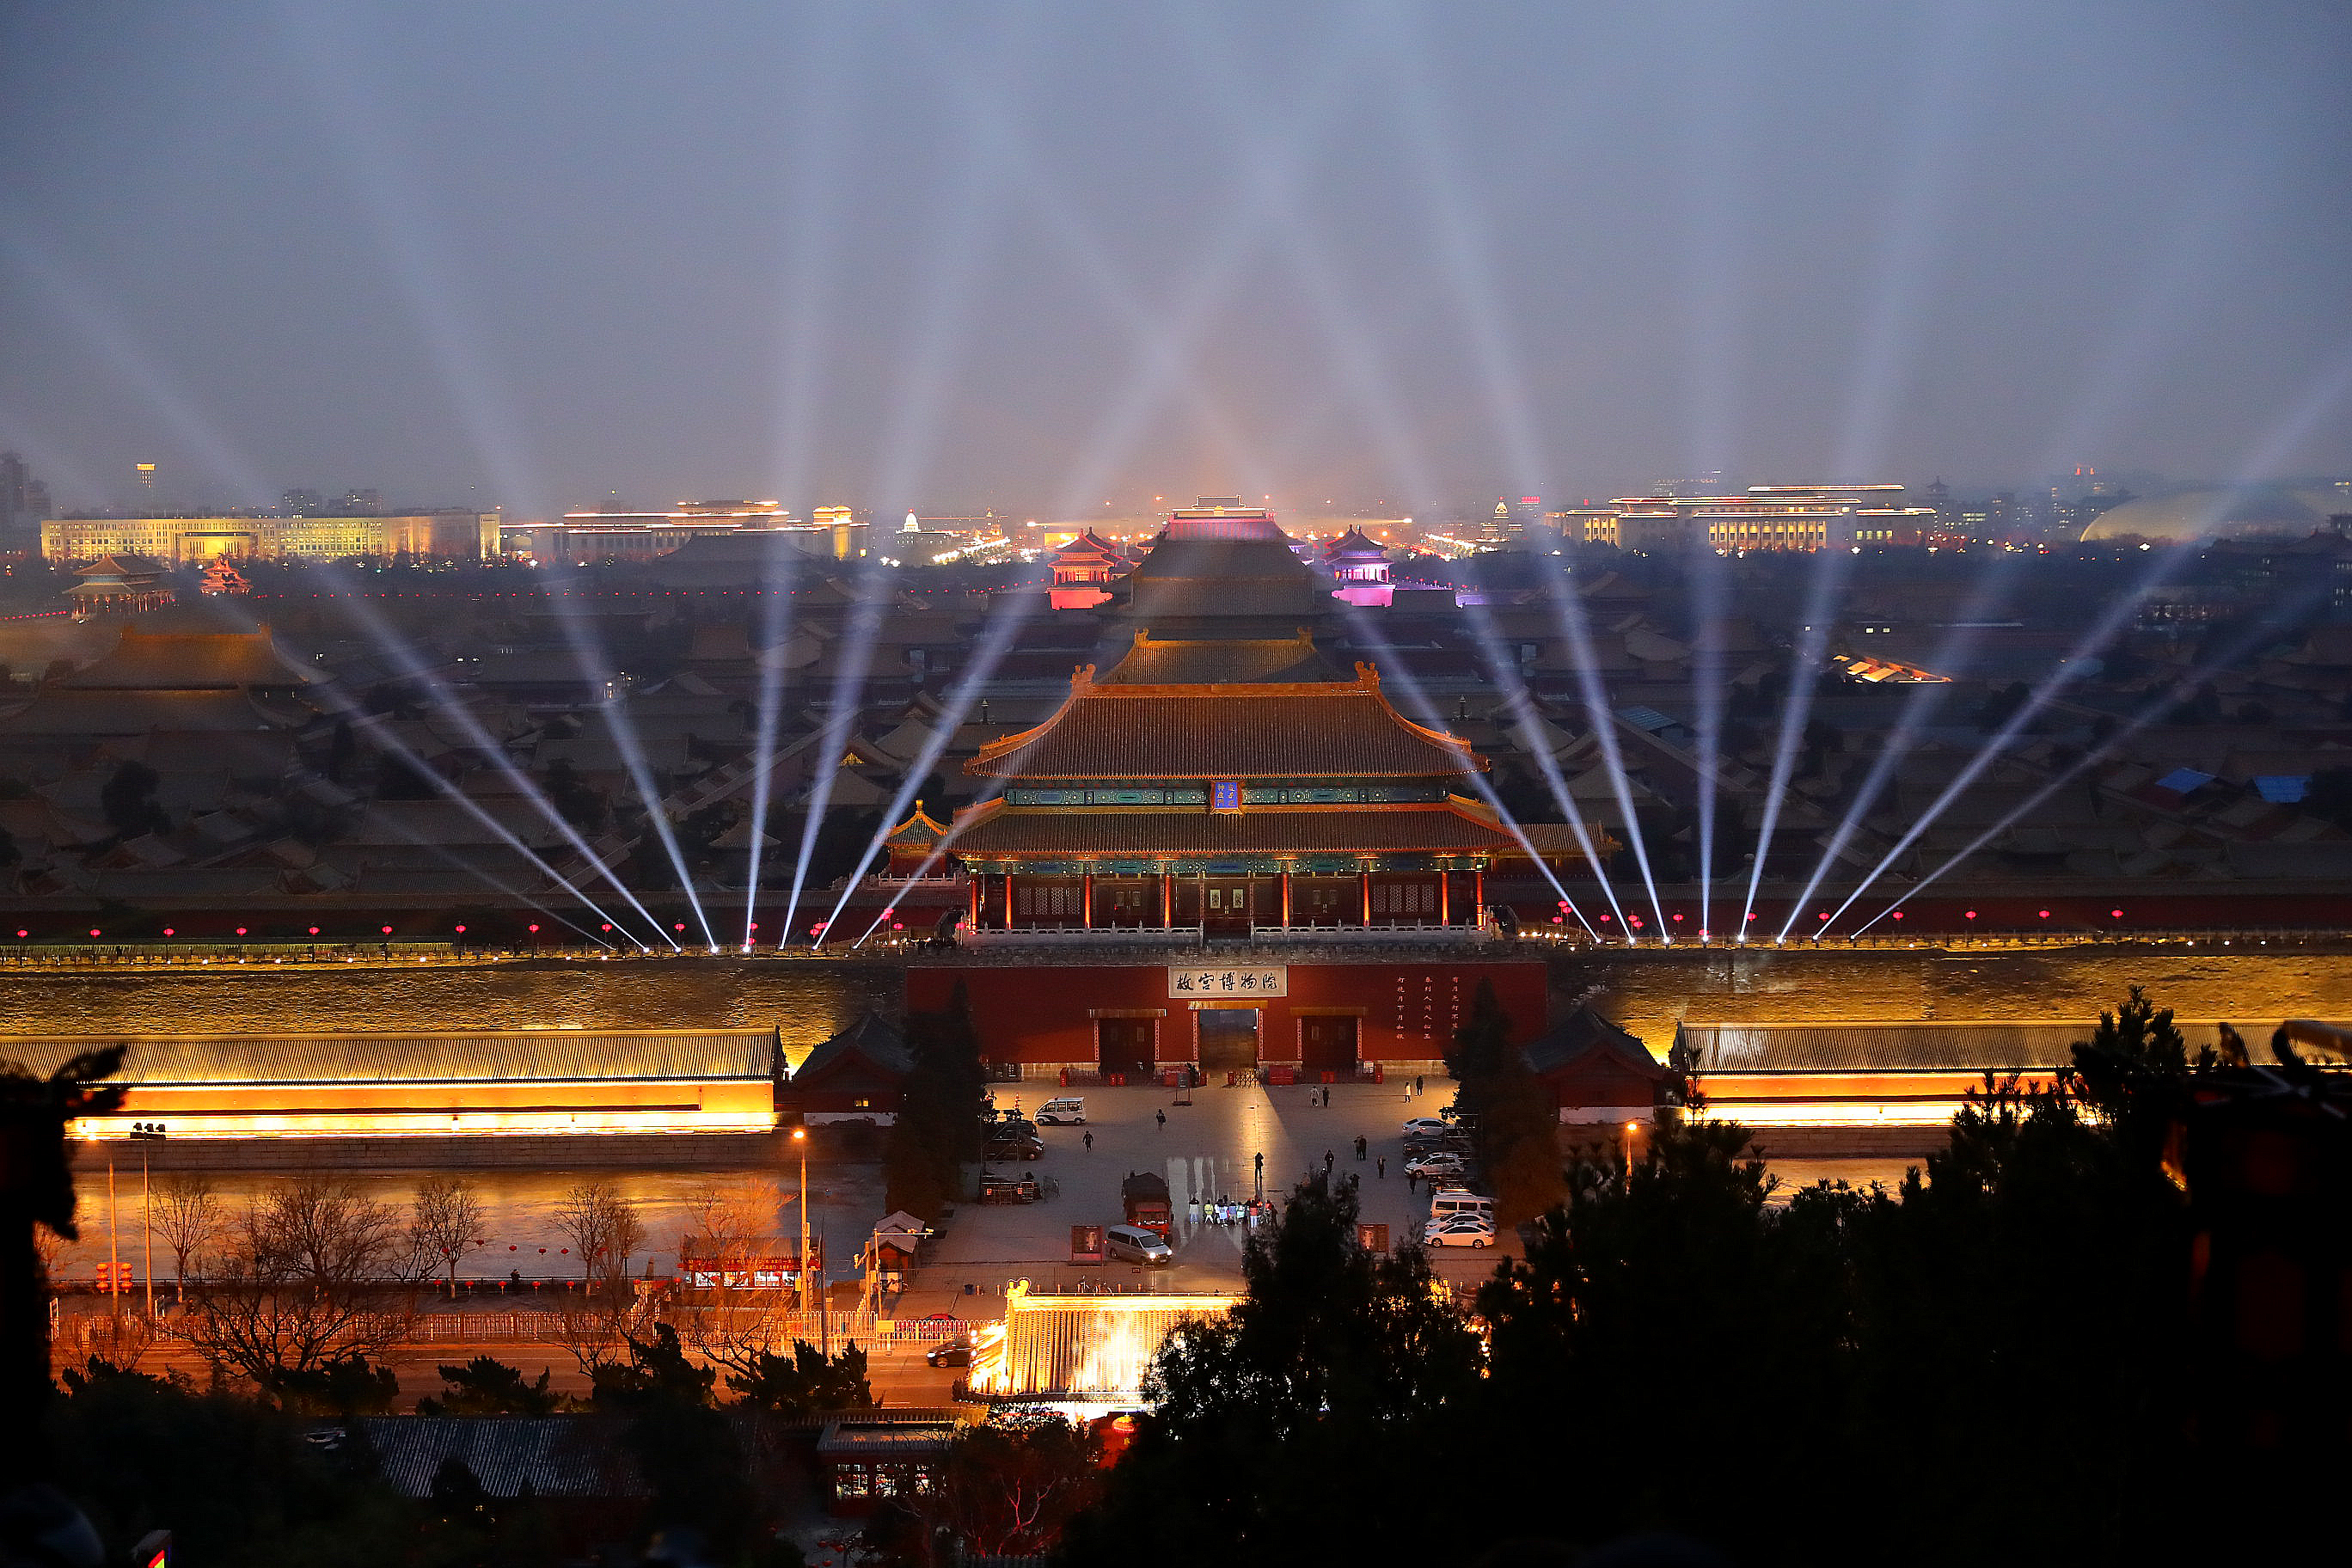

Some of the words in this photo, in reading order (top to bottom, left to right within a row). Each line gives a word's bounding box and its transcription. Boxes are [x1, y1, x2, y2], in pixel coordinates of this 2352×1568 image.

[1176, 971, 1278, 991] 故宫博物院
